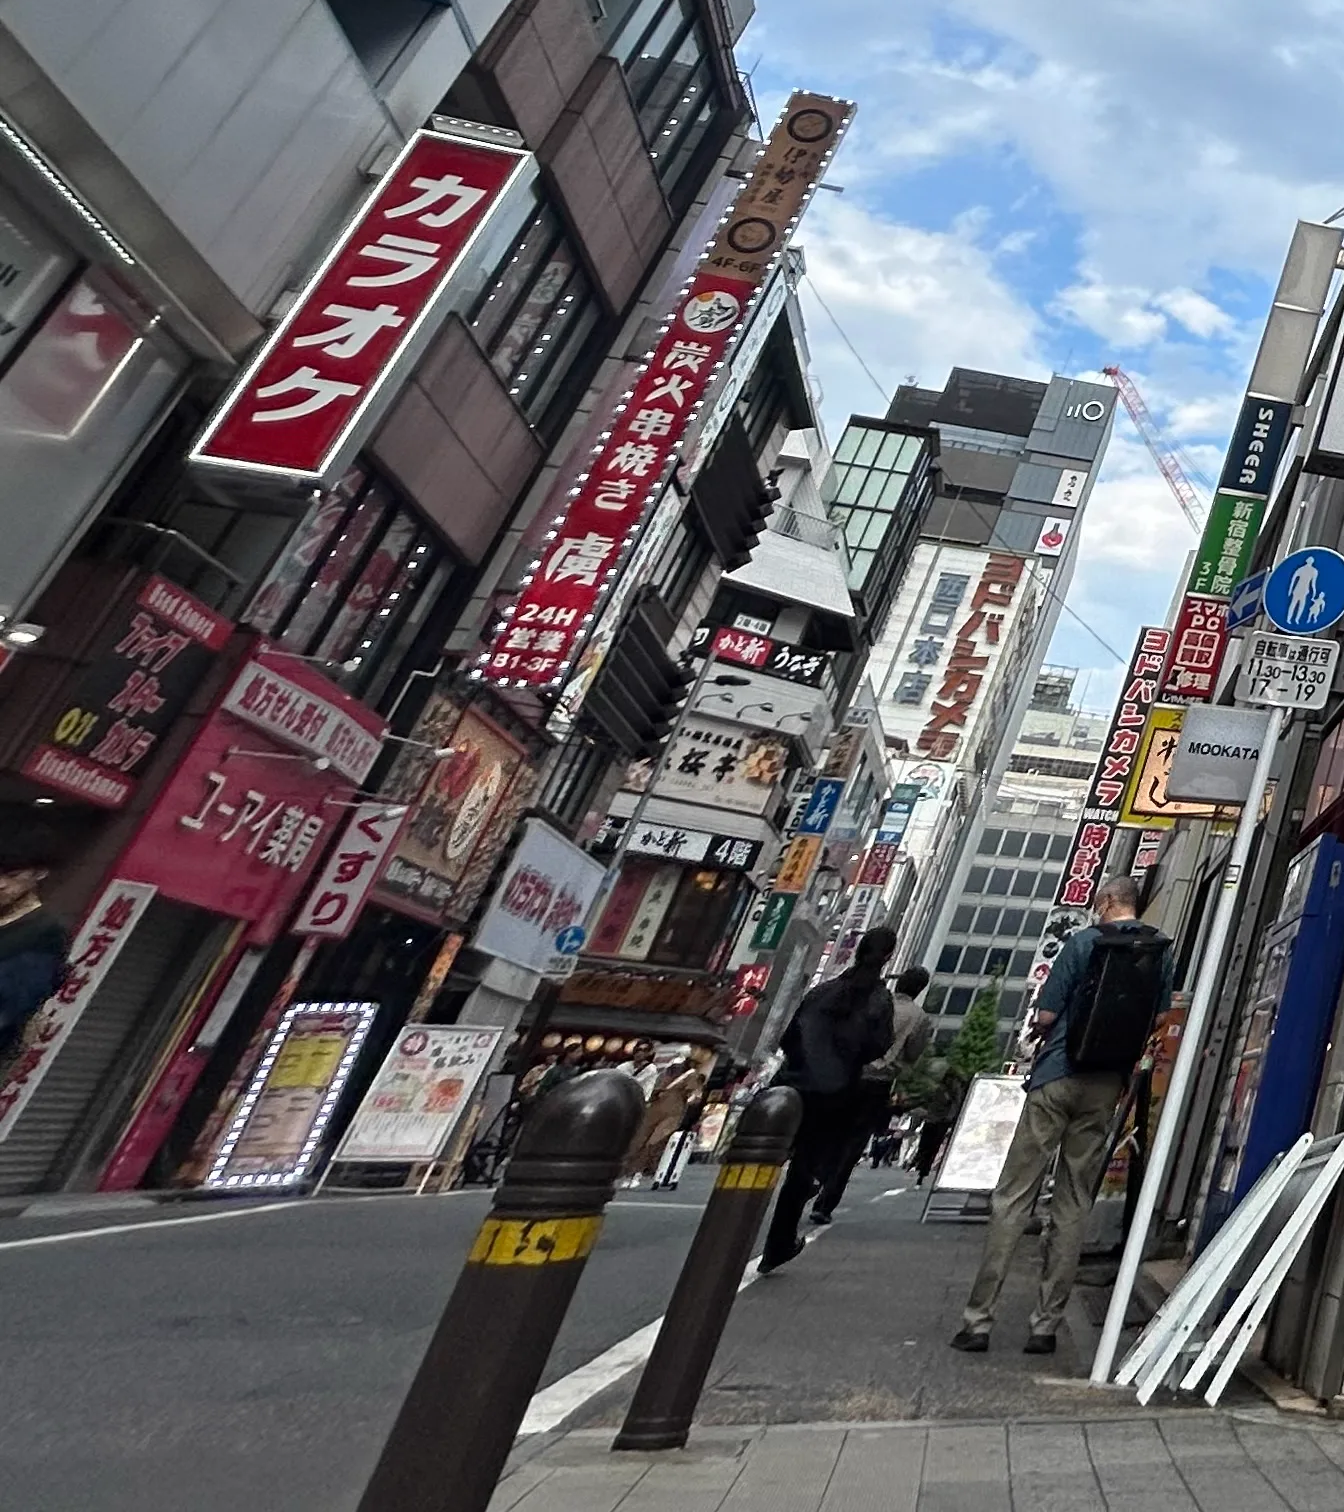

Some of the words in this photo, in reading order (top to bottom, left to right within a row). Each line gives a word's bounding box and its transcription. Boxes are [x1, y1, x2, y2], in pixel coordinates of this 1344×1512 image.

[252, 174, 487, 423] カラオケ
[595, 340, 711, 512] 炭火串焼き
[1239, 407, 1274, 485] SHEER
[1210, 500, 1253, 595] 新宿整骨院
[505, 627, 566, 653] 営業
[518, 603, 577, 626] 24H
[894, 572, 970, 705] 西口本店
[1191, 614, 1221, 631] PC
[1255, 639, 1332, 664] 自転車は通行可
[493, 654, 557, 672] B1-3F
[773, 646, 824, 678] うなぎ
[917, 553, 1025, 759] ヨドバシカメラ
[1096, 628, 1171, 806] ヨドバシカメラ
[1188, 742, 1259, 761] MOOKATA
[1084, 807, 1119, 823] WATCH
[309, 814, 383, 926] くすり
[1061, 823, 1110, 906] 時計館
